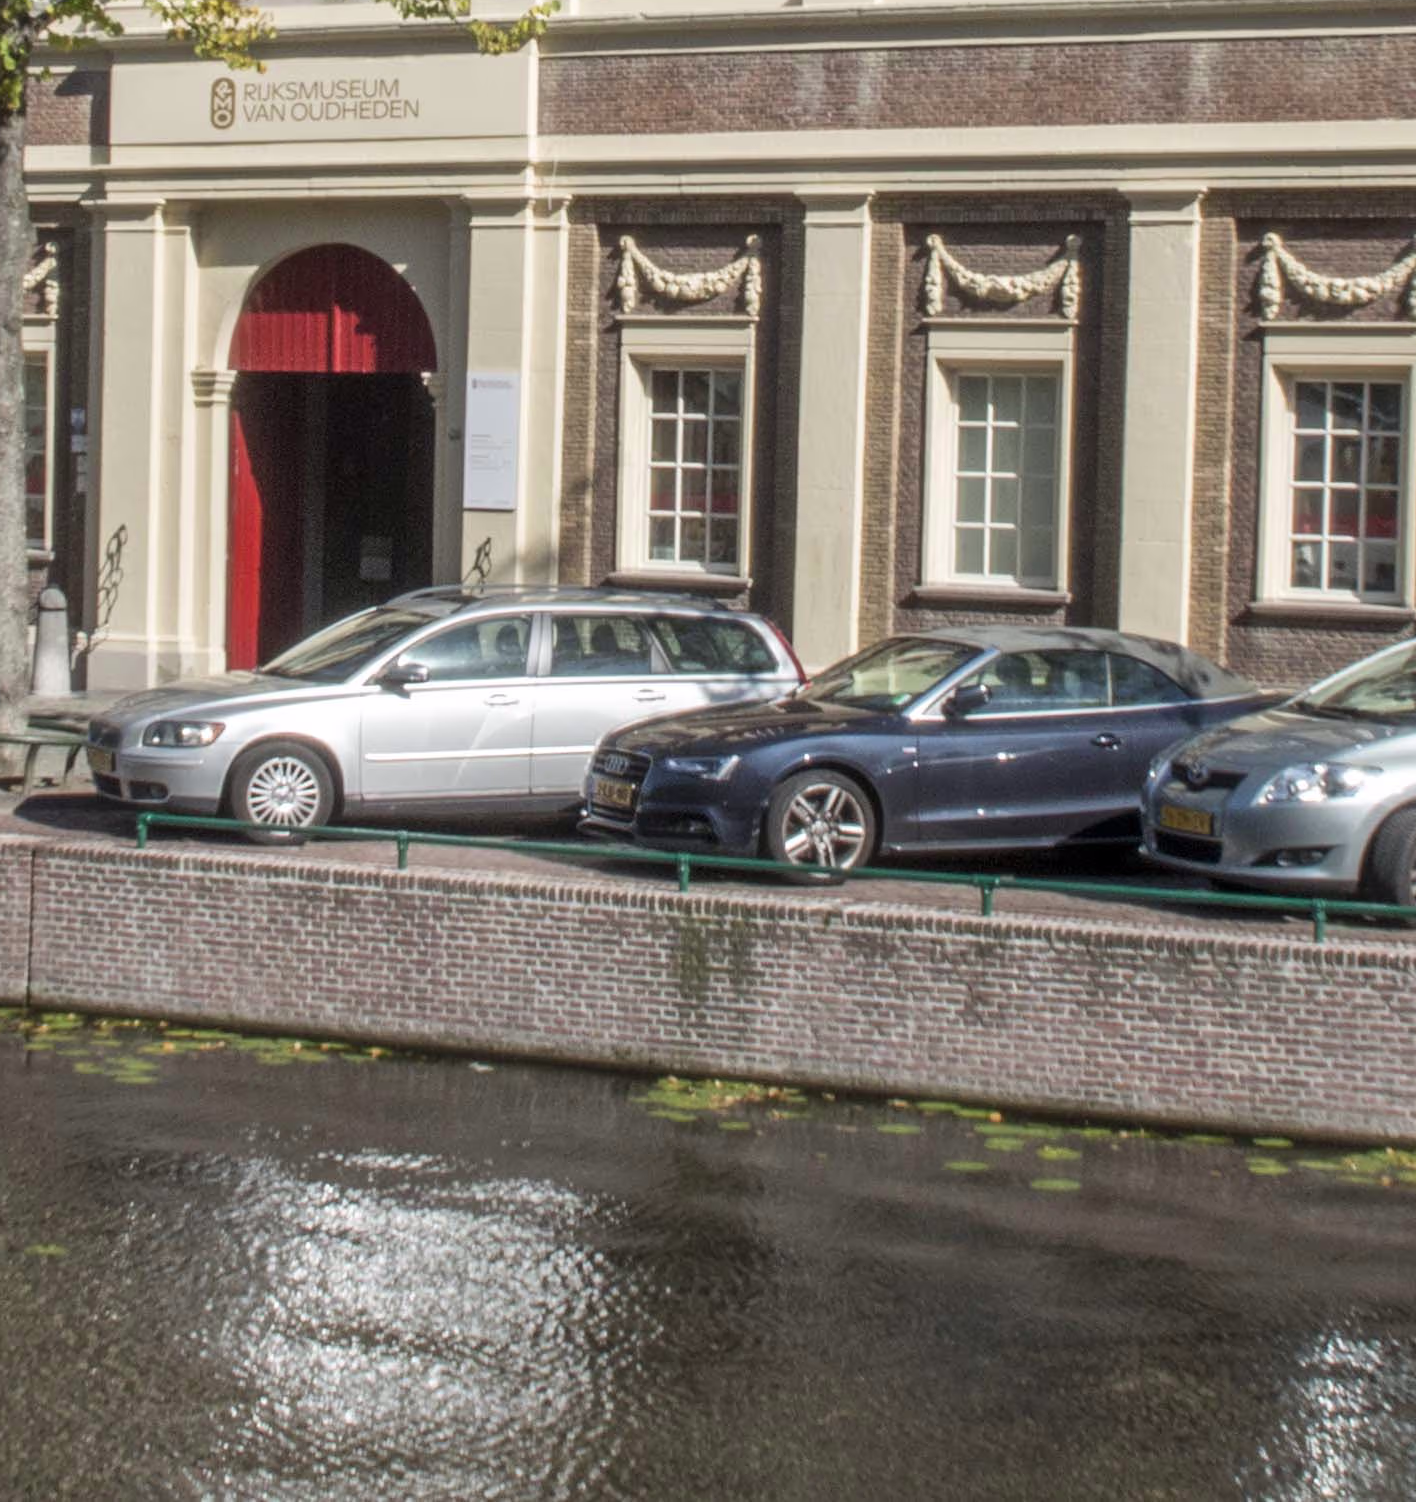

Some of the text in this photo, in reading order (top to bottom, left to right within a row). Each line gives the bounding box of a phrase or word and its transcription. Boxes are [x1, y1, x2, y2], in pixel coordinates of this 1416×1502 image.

[244, 78, 399, 101] RIJKSMUSEUM
[243, 98, 420, 123] VAN OUDHEDEN
